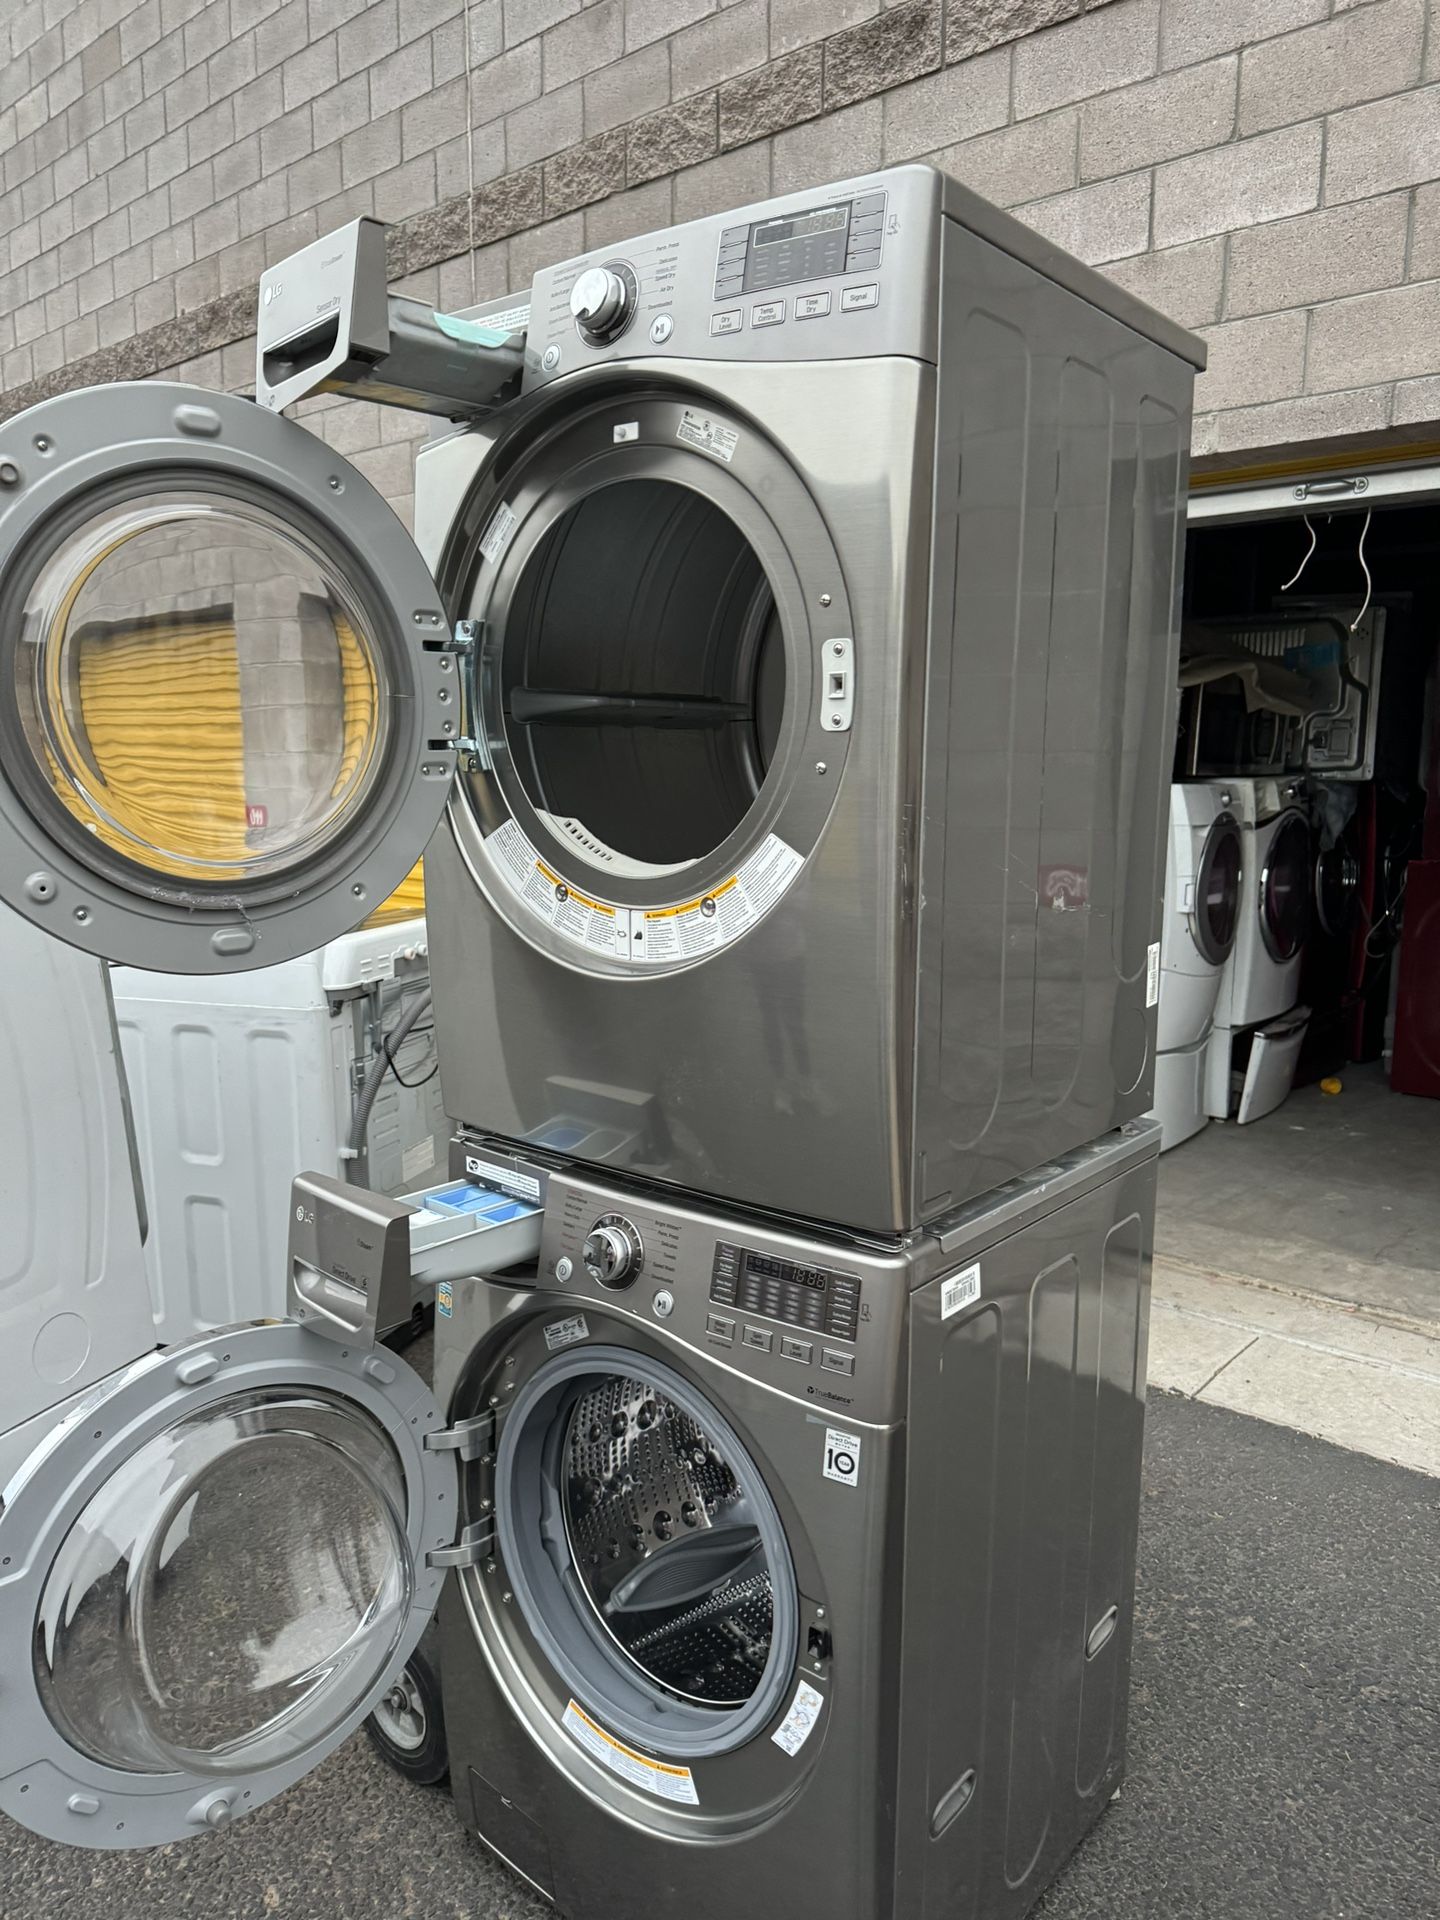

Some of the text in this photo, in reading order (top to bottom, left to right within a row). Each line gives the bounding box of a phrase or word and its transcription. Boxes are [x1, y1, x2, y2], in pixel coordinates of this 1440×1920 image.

[272, 283, 282, 299] LG
[850, 293, 867, 301] Signal
[316, 300, 333, 314] Sensor
[758, 314, 777, 322] Control
[719, 322, 732, 330] Level
[305, 1210, 314, 1224] LG
[827, 1434, 843, 1443] Direct
[843, 1438, 858, 1448] Drive
[828, 1448, 855, 1475] 10
